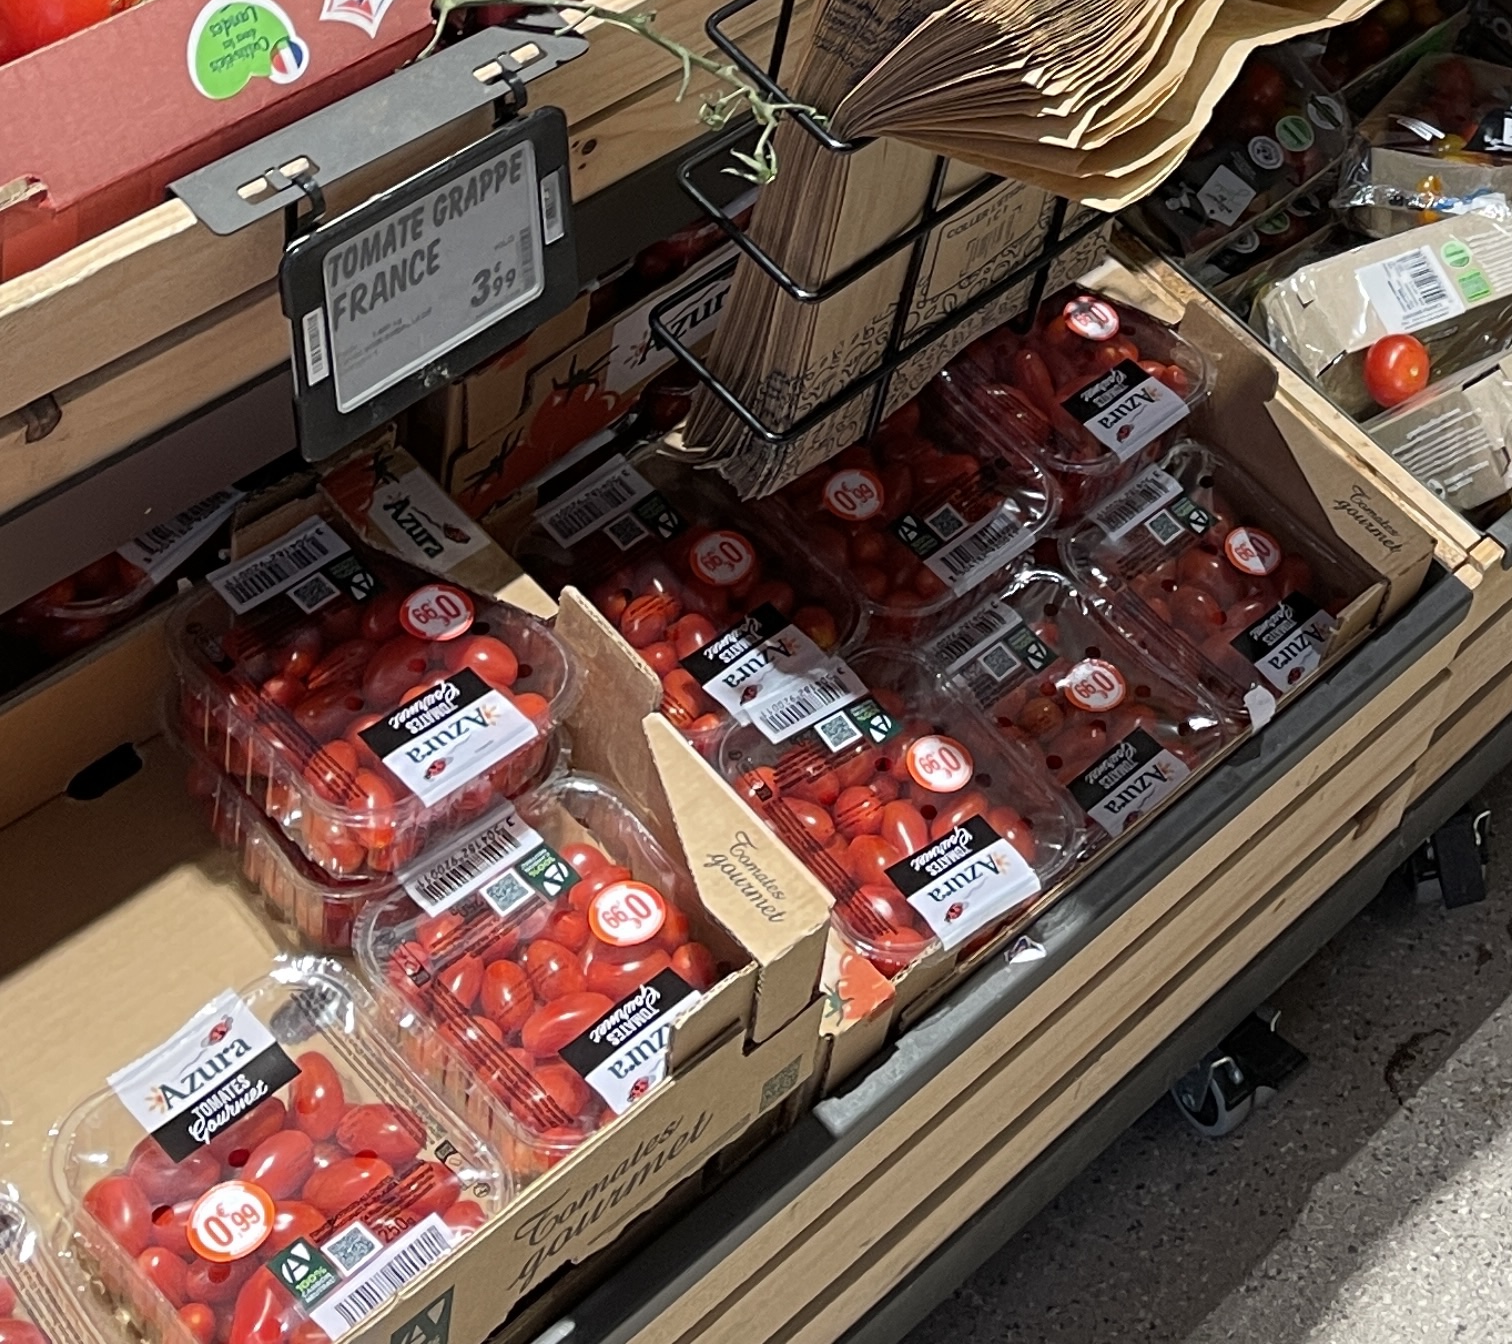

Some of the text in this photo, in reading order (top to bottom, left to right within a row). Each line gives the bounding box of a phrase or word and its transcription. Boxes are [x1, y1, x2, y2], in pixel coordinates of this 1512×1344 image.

[208, 4, 259, 38] Landes
[327, 149, 524, 289] TOMATE GRAPPE
[331, 237, 441, 332] FRANCE
[1097, 386, 1156, 431] Azura
[382, 495, 446, 559] Azura
[1332, 498, 1404, 554] gourmet
[1349, 483, 1400, 537] Tomates
[721, 637, 794, 690] Azura
[387, 679, 461, 731] Gourmet
[404, 701, 459, 735] TOMATES
[404, 706, 491, 765] Azura
[1103, 763, 1169, 816] Azura
[729, 829, 787, 902] Tomates
[926, 852, 999, 903] Azura
[927, 840, 974, 878] TOMATES
[703, 852, 786, 925] gourmet
[588, 983, 662, 1045] Gourmet
[606, 1005, 661, 1047] TOMATES
[158, 1036, 253, 1112] Azura
[606, 1022, 671, 1081] zura
[187, 1078, 270, 1146] Gourmet
[191, 1072, 252, 1122] TOMATES
[506, 1111, 715, 1295] gourmet
[513, 1116, 686, 1247] Tomates
[376, 1214, 418, 1244] 250g
[295, 1264, 329, 1295] 100%
